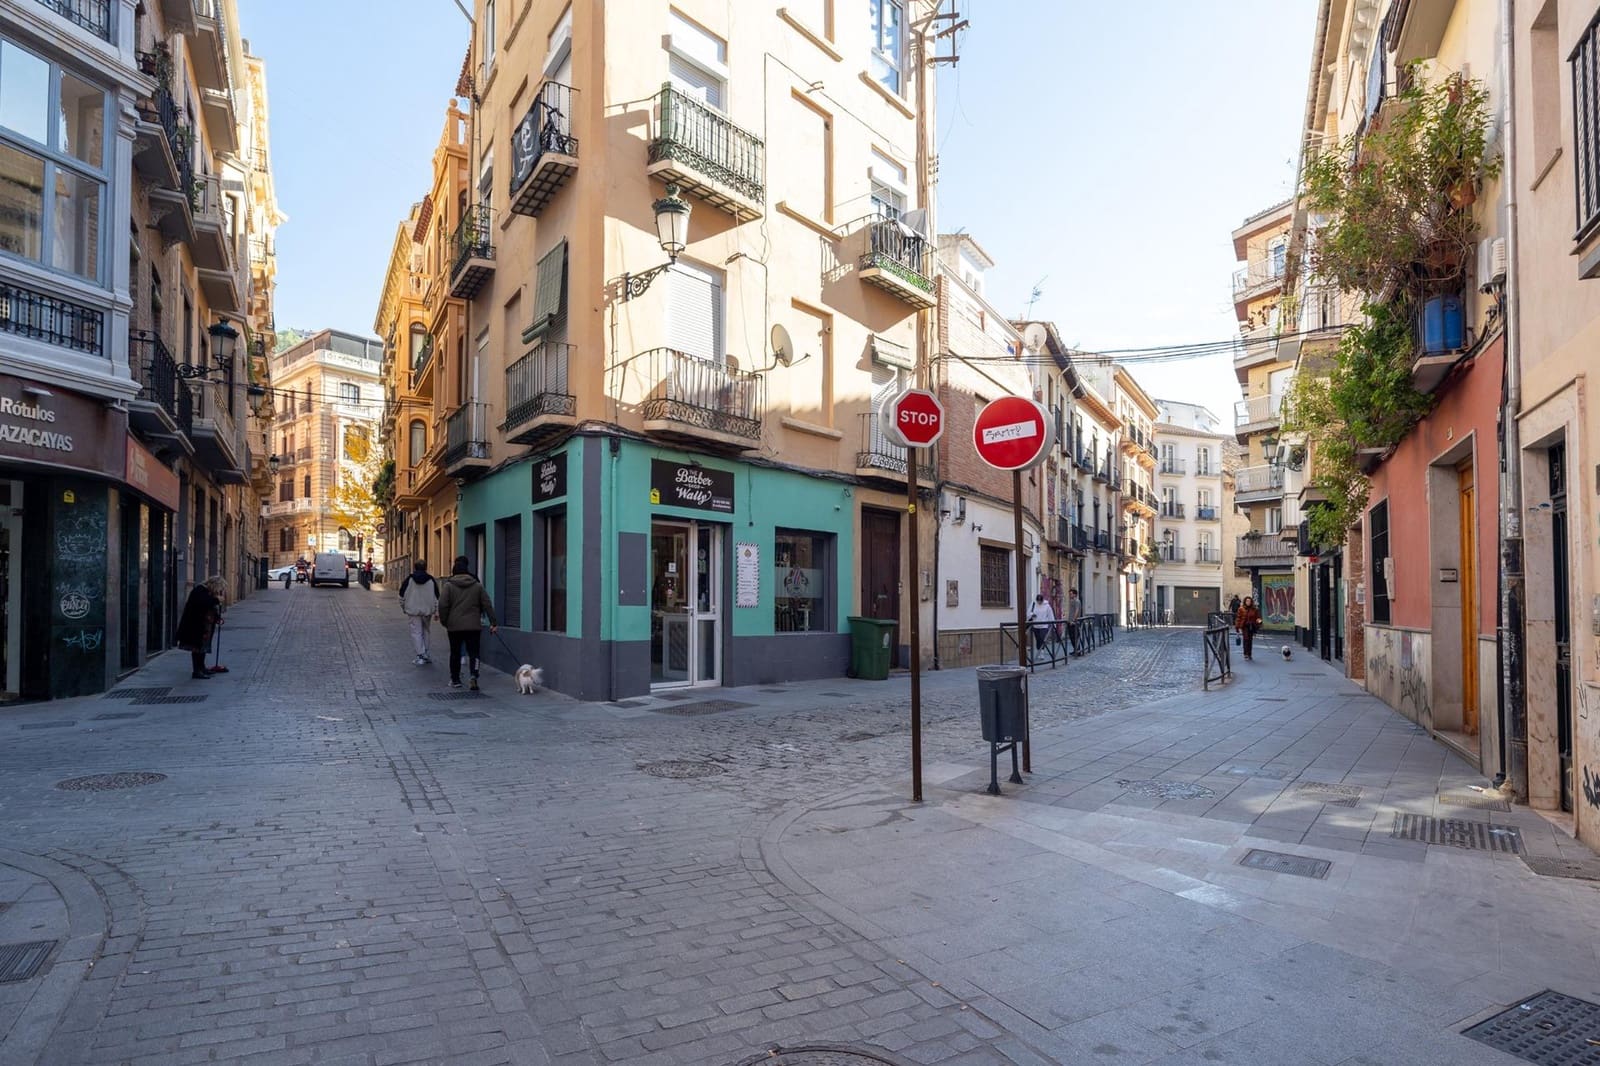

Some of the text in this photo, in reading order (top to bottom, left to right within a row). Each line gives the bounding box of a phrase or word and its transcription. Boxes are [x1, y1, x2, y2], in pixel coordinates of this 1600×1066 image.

[0, 397, 56, 423] Rótulos
[900, 410, 938, 426] STOP
[0, 424, 73, 452] AZACAYAS
[675, 467, 714, 486] Barber
[675, 486, 713, 505] Wally
